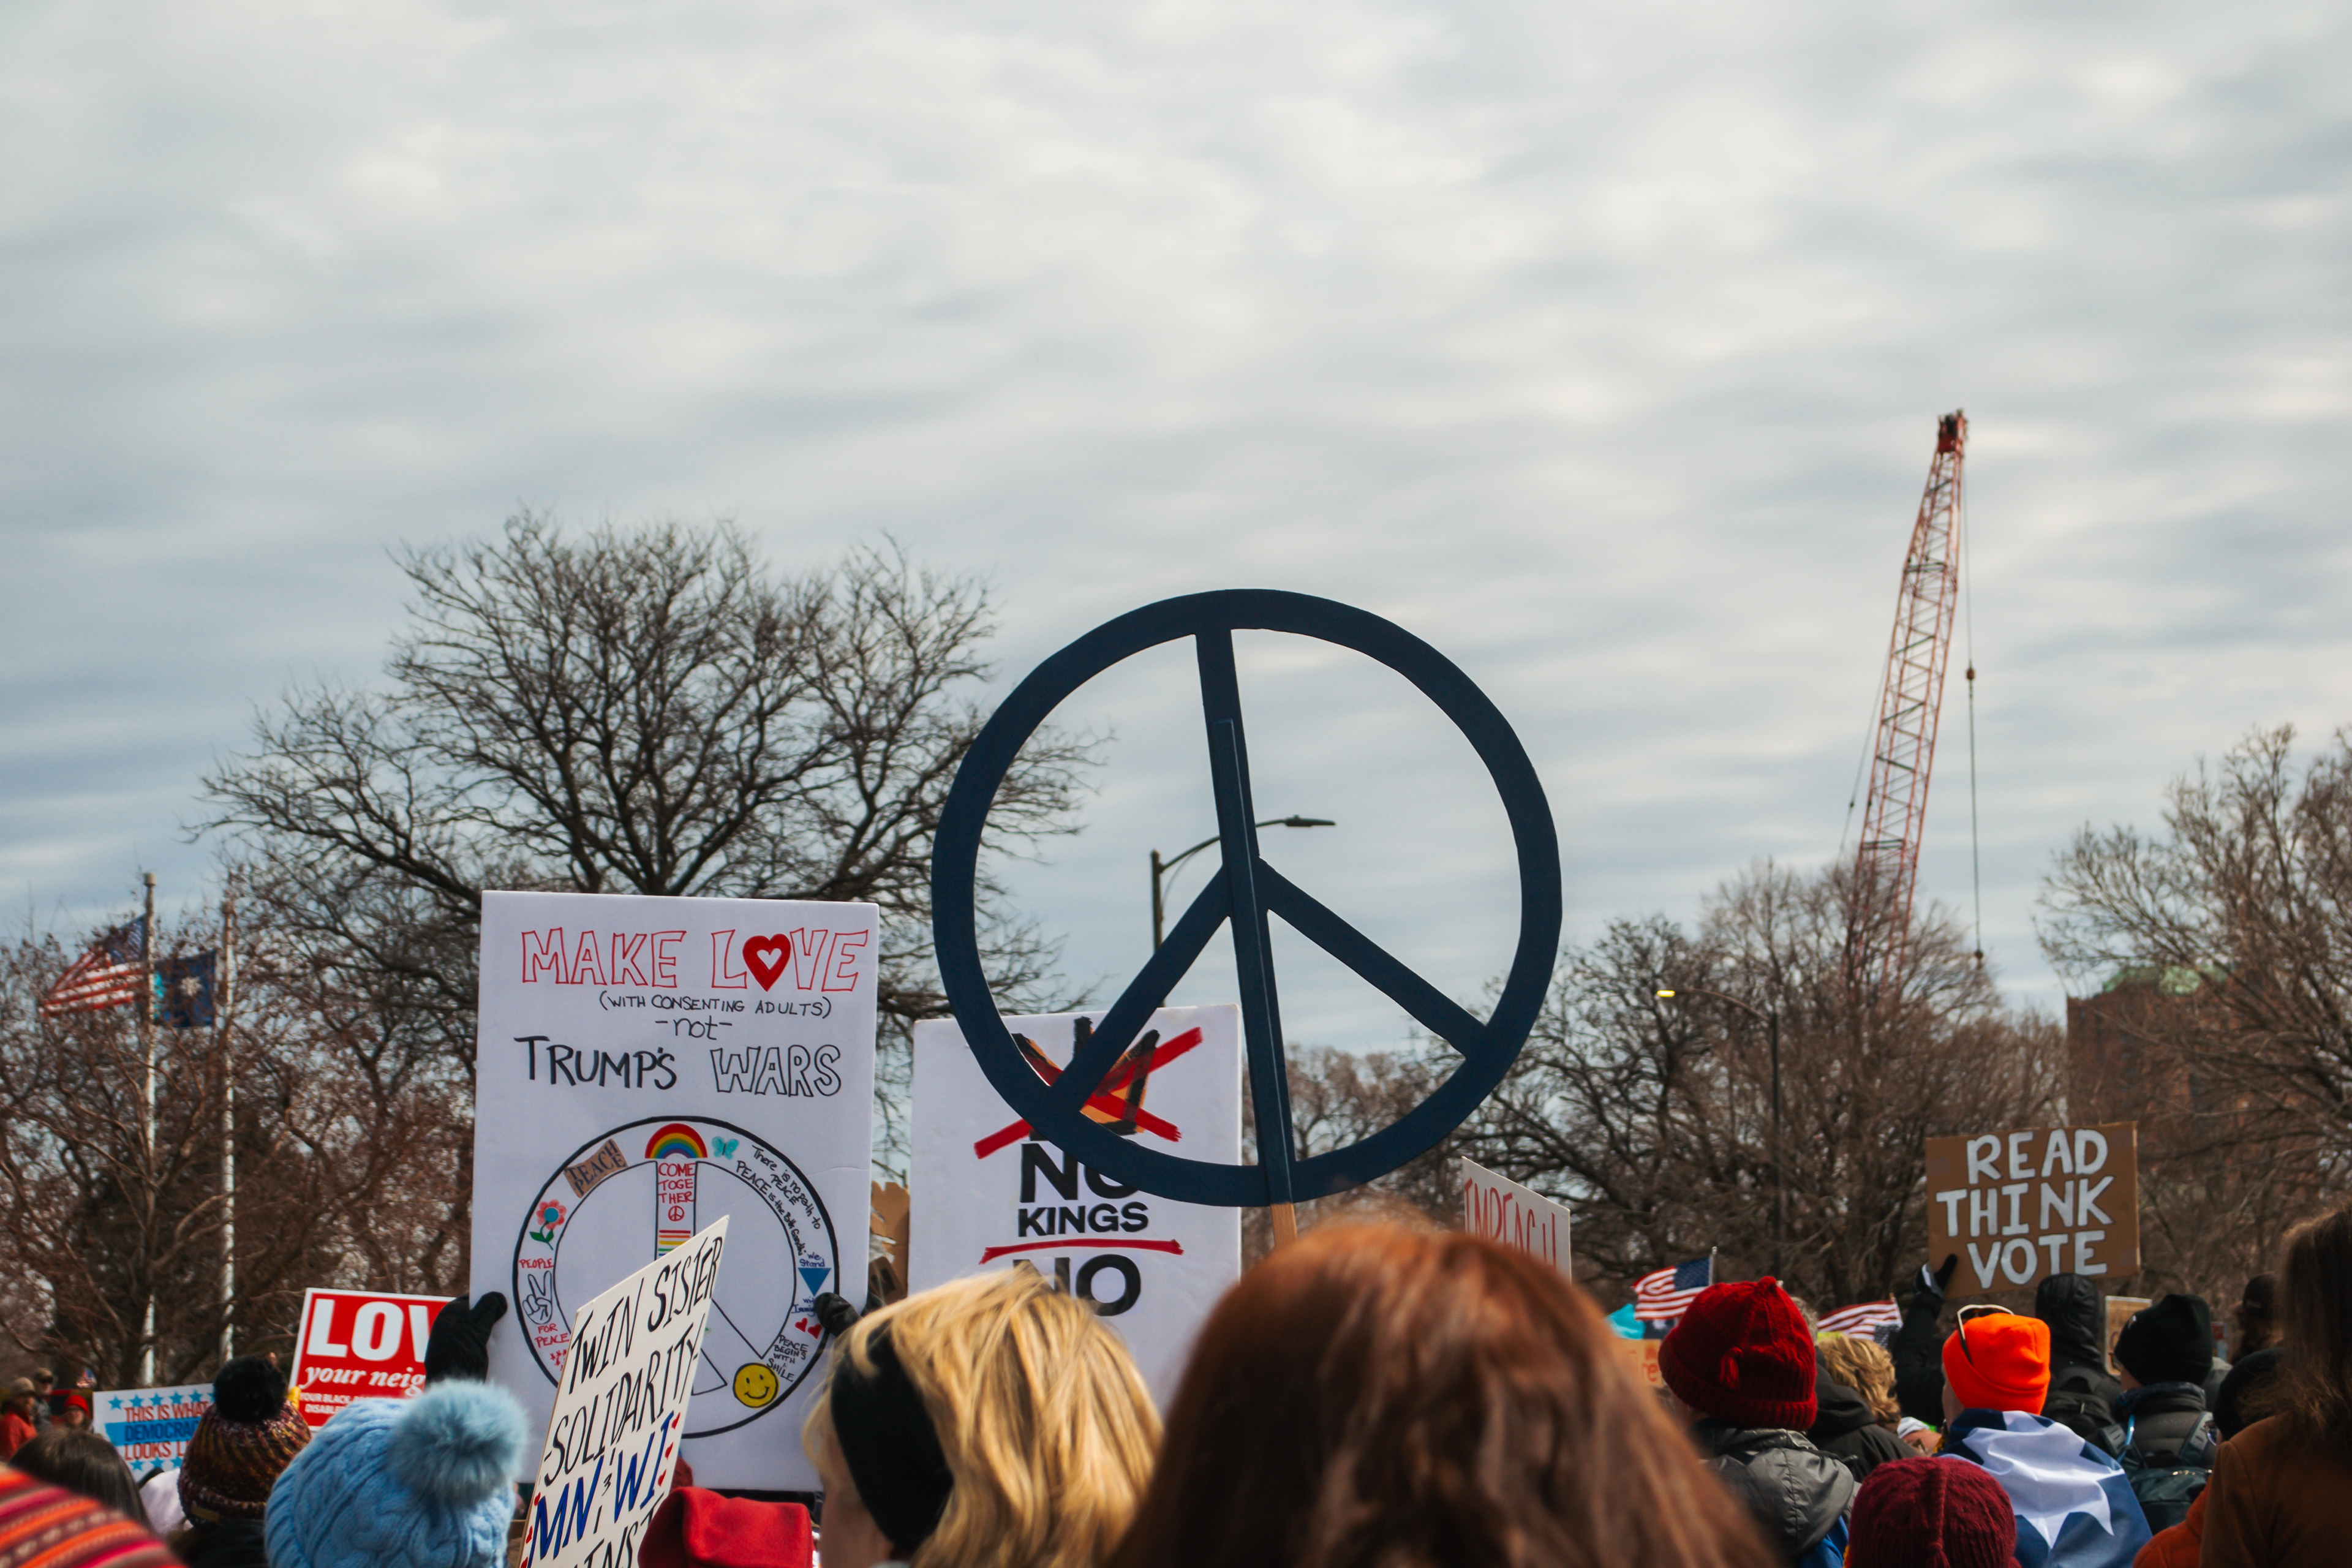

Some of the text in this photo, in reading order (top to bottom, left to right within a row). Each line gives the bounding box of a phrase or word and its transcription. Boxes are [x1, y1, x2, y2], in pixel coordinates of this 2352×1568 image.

[521, 927, 687, 989] MAKE
[599, 990, 831, 1019] (WITH CONSENTING ADULTS)
[710, 1044, 842, 1098] WARS
[564, 1139, 619, 1185] TEACH
[658, 1163, 695, 1177] COME
[1966, 1129, 2108, 1184] READ
[658, 1178, 693, 1191] TOGE
[736, 1160, 772, 1195] PEACE
[752, 1145, 777, 1171] There
[781, 1169, 790, 1182] is
[790, 1180, 801, 1194] no
[812, 1216, 820, 1229] to
[771, 1174, 799, 1205] PEACE
[658, 1191, 694, 1204] THER
[1936, 1175, 2114, 1237] THINK
[1018, 1201, 1148, 1237] KINGS
[519, 1258, 554, 1269] PEOPLE
[1966, 1229, 2108, 1289] VOTE
[306, 1298, 429, 1363] LOV
[538, 1323, 558, 1334] FOR
[569, 1236, 723, 1395] TWIN SISTER
[535, 1333, 570, 1348] PEACE
[774, 1344, 806, 1360] BEGINS
[778, 1335, 809, 1353] PEACE
[773, 1352, 796, 1364] WITH
[298, 1366, 426, 1397] your neig
[123, 1401, 209, 1423] THIS IS WHAT
[125, 1420, 199, 1441] DEMOCRAC
[124, 1441, 172, 1460] LOOKS
[527, 1455, 604, 1568] MN
[614, 1411, 674, 1523] WI
